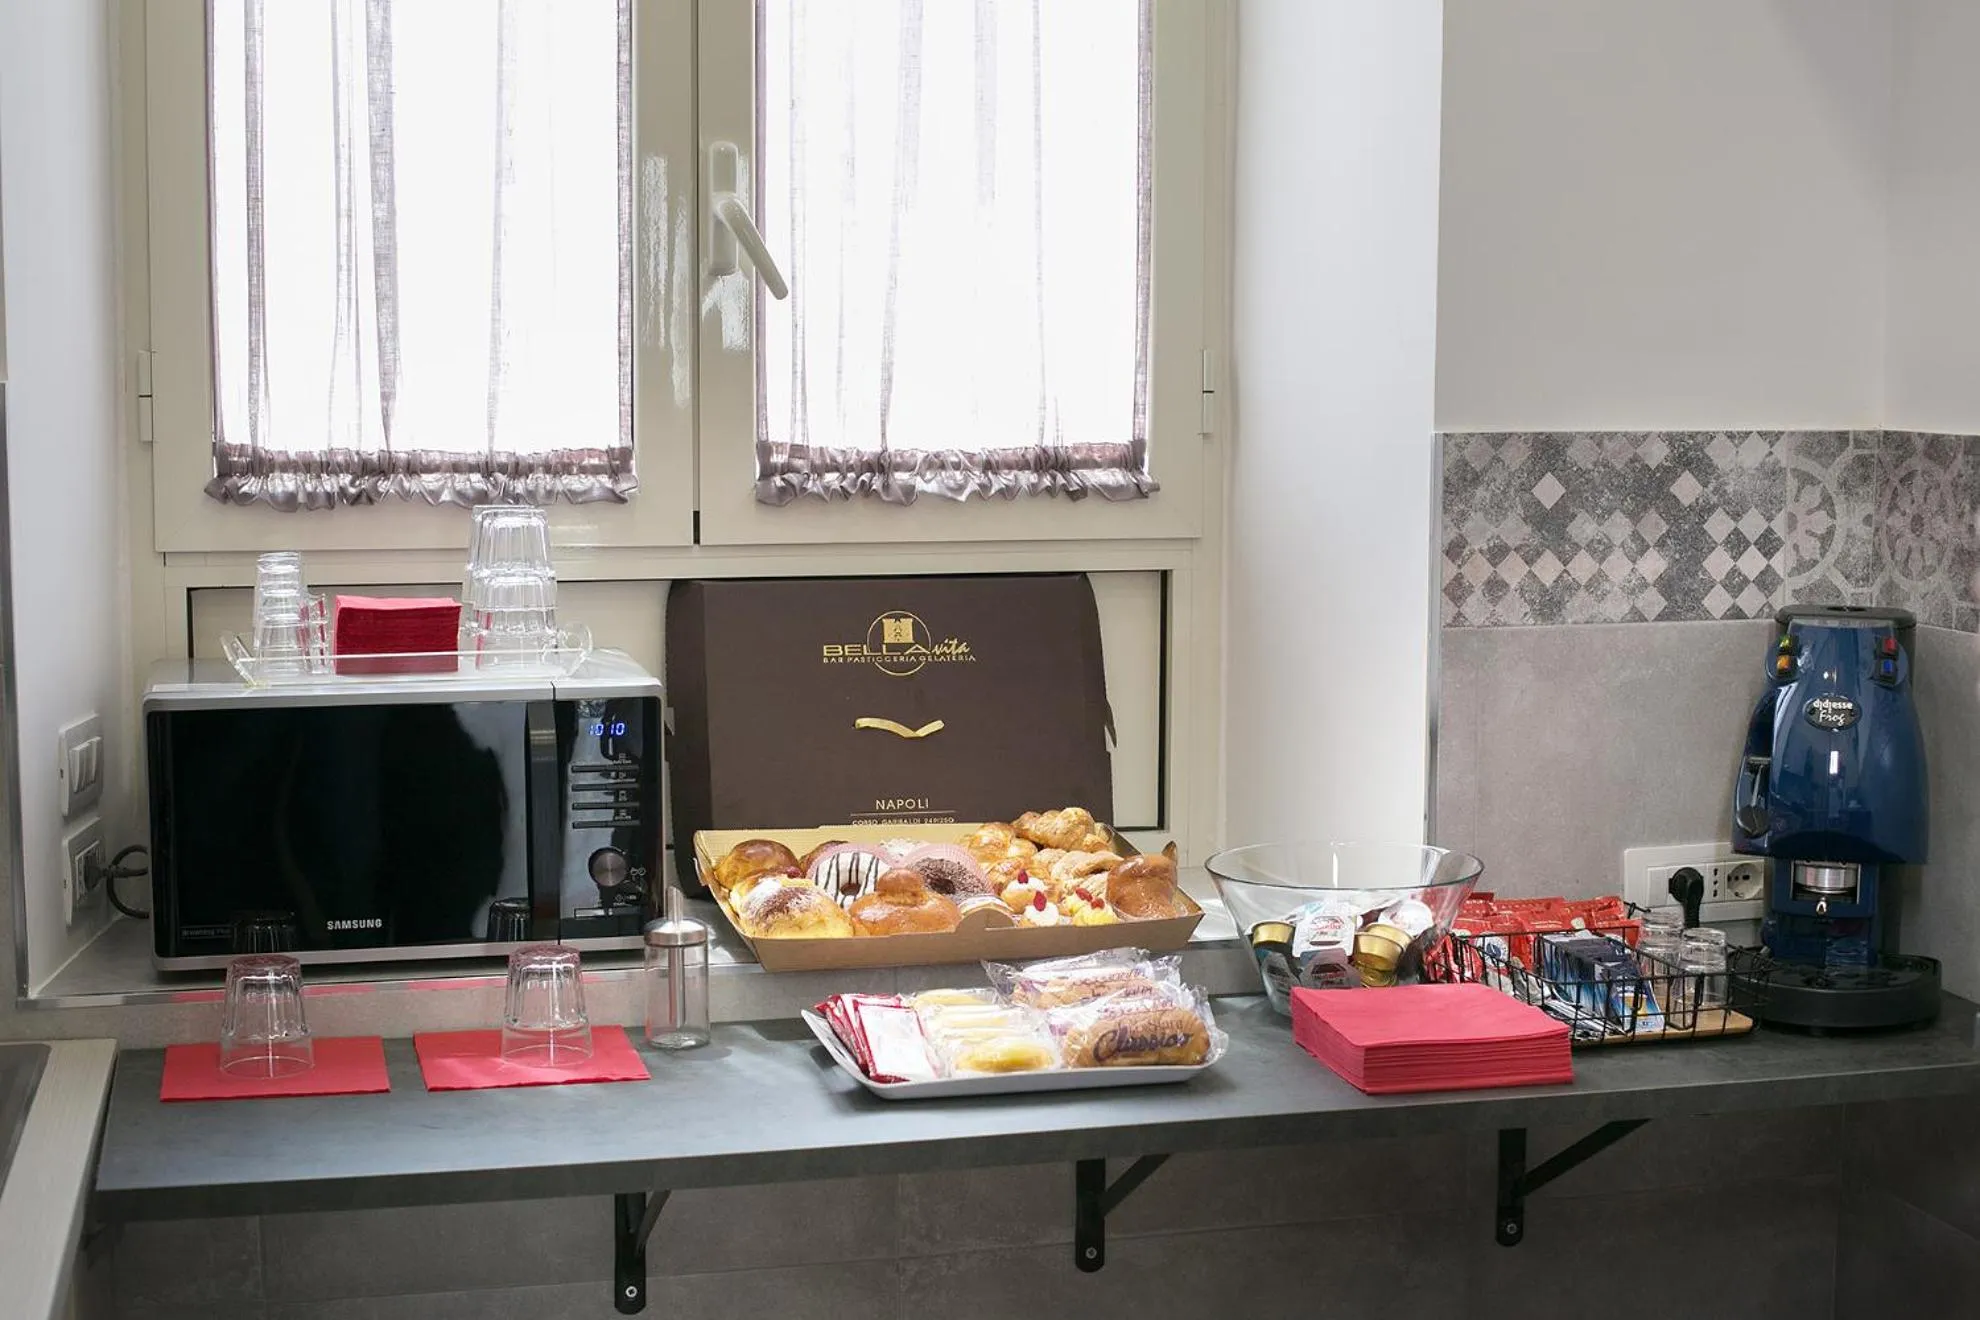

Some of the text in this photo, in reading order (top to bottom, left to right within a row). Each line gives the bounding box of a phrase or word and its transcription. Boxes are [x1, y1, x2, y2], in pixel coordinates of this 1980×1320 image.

[822, 637, 971, 656] BELLA vita
[823, 654, 977, 664] BAR PASTICCERIA GELATERIA
[875, 797, 929, 810] NAPOLI
[326, 918, 383, 930] SAMSUNG
